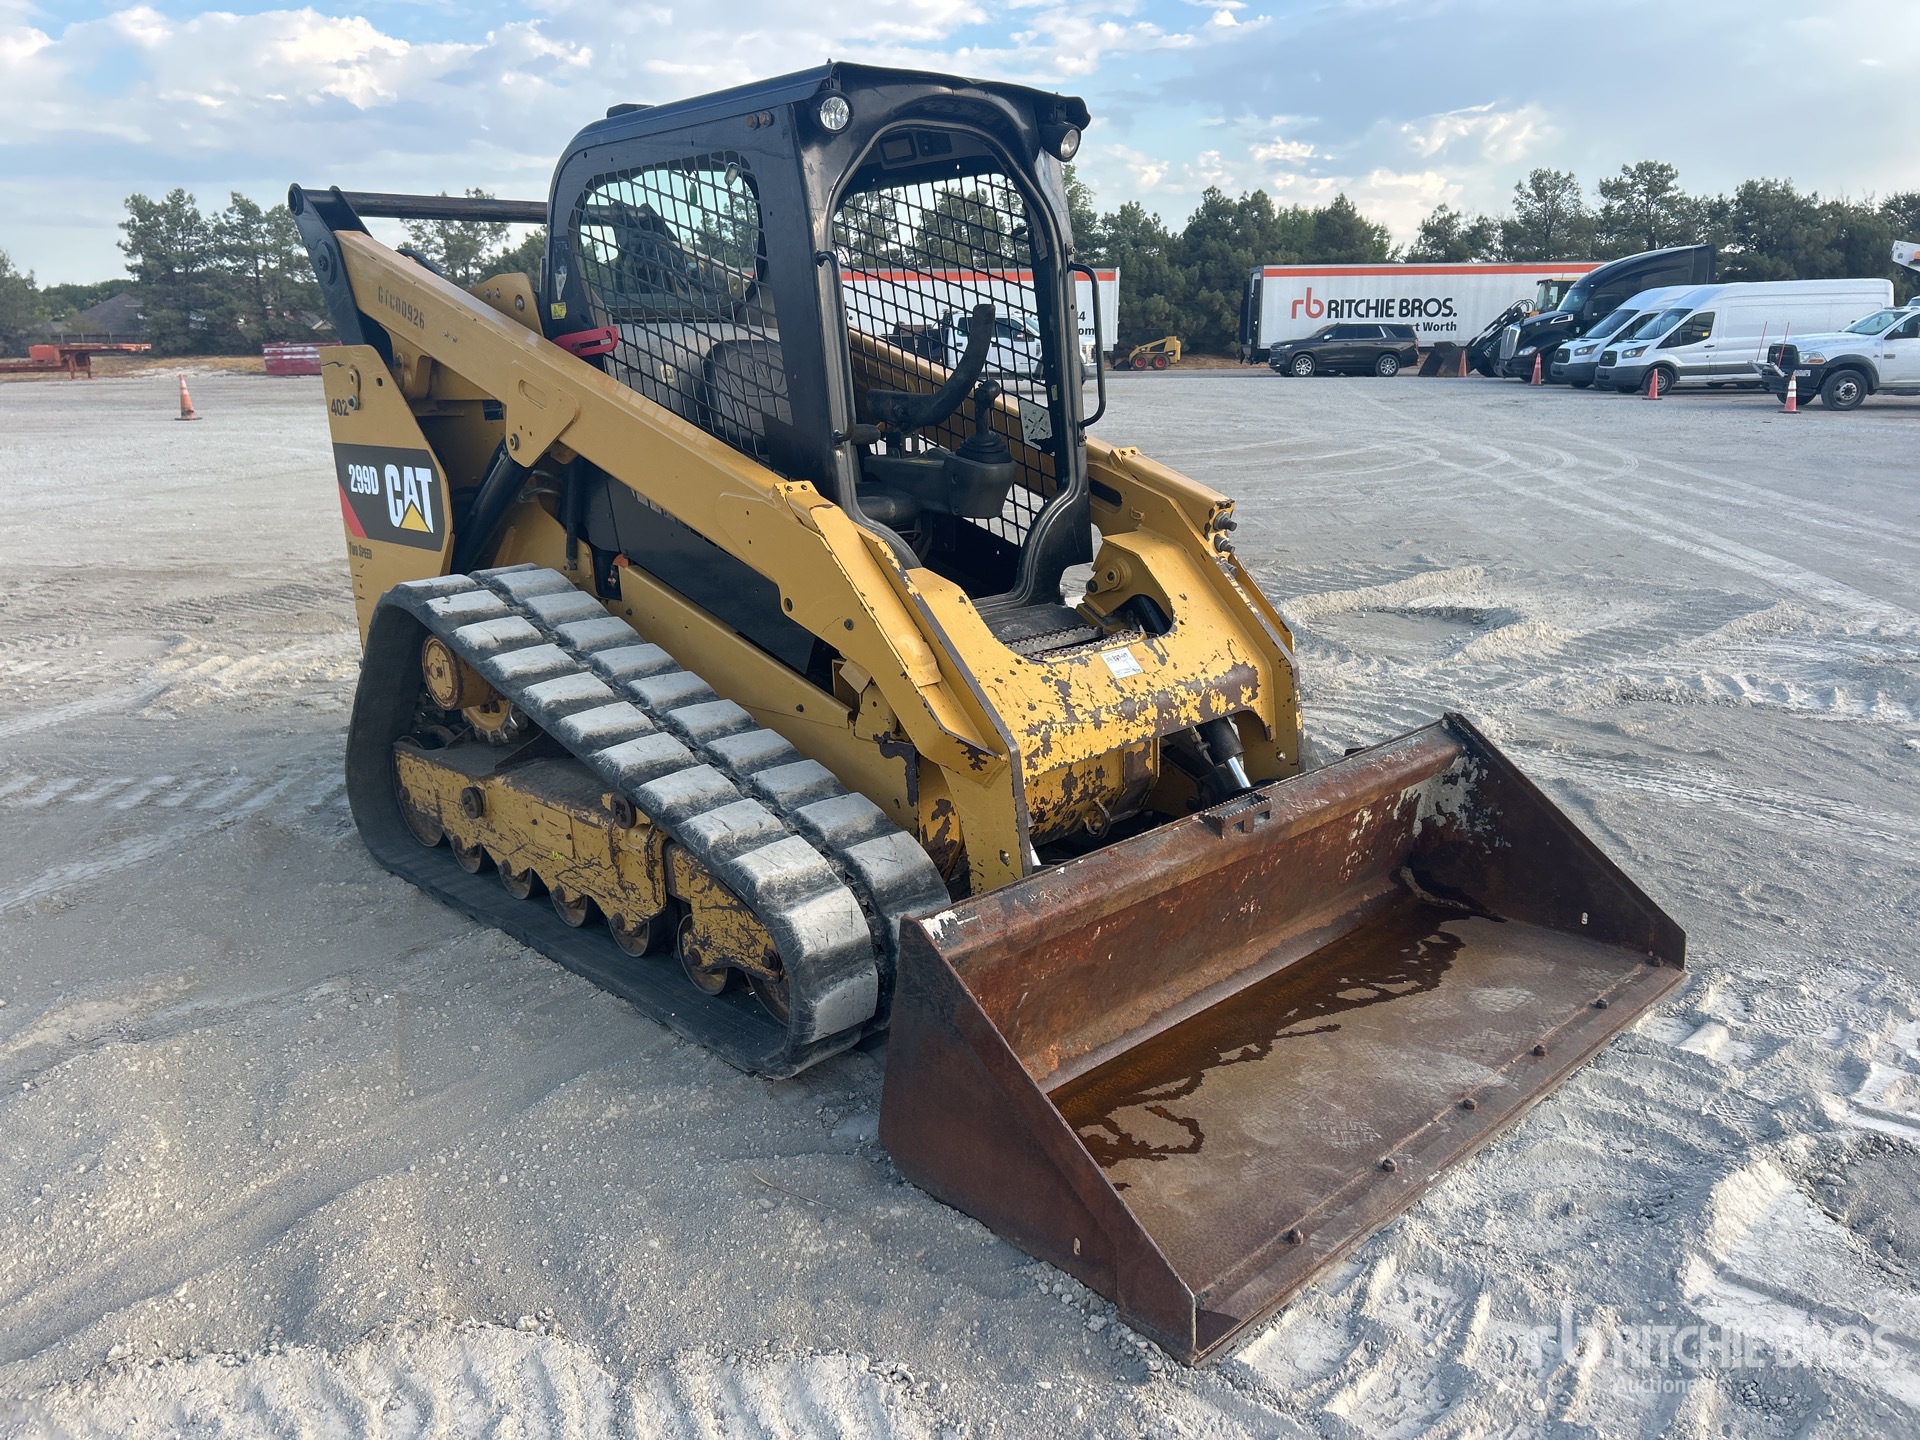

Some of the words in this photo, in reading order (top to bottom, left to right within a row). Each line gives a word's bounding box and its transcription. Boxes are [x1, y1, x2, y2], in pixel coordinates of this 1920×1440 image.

[1291, 287, 1325, 319] rb
[1327, 299, 1395, 318] RITCHIE
[1399, 298, 1458, 317] BROS.
[1423, 321, 1457, 331] Worth
[331, 398, 349, 416] 402
[348, 463, 379, 496] 299D
[384, 463, 434, 534] CAT
